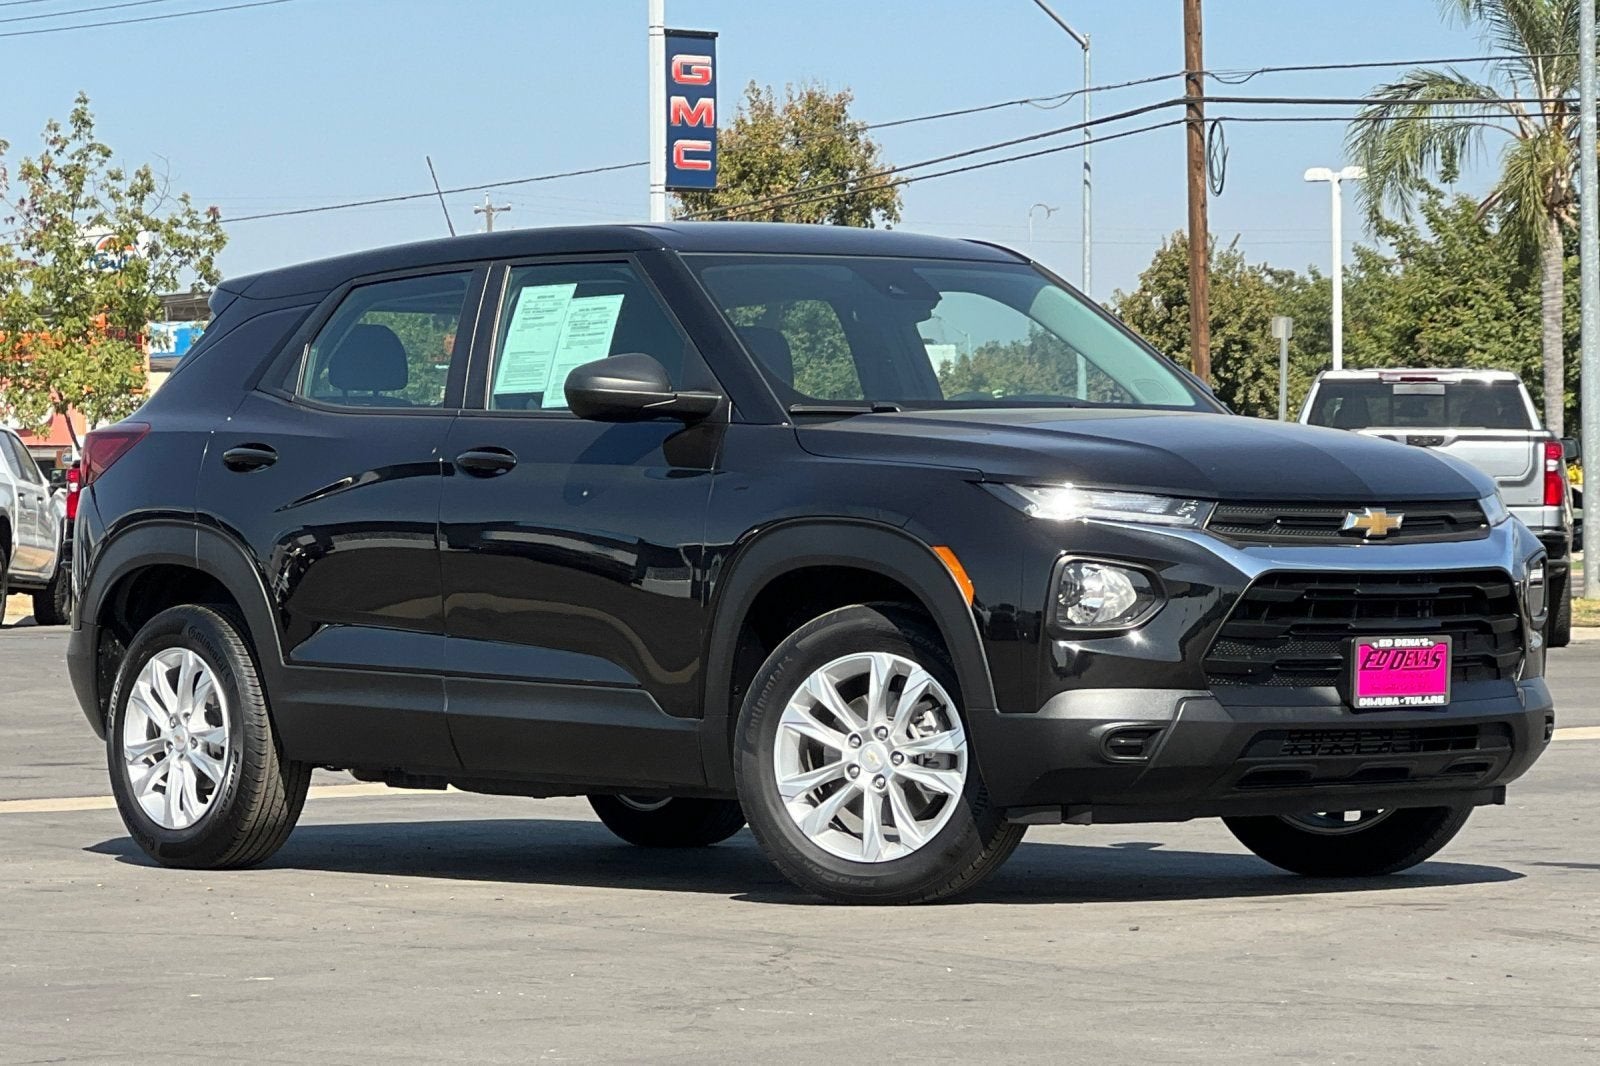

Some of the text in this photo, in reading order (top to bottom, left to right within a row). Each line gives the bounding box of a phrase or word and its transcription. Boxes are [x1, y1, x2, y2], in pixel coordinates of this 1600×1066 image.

[670, 54, 715, 171] GMC
[1379, 639, 1393, 647] ED
[1404, 695, 1445, 705] TULARE
